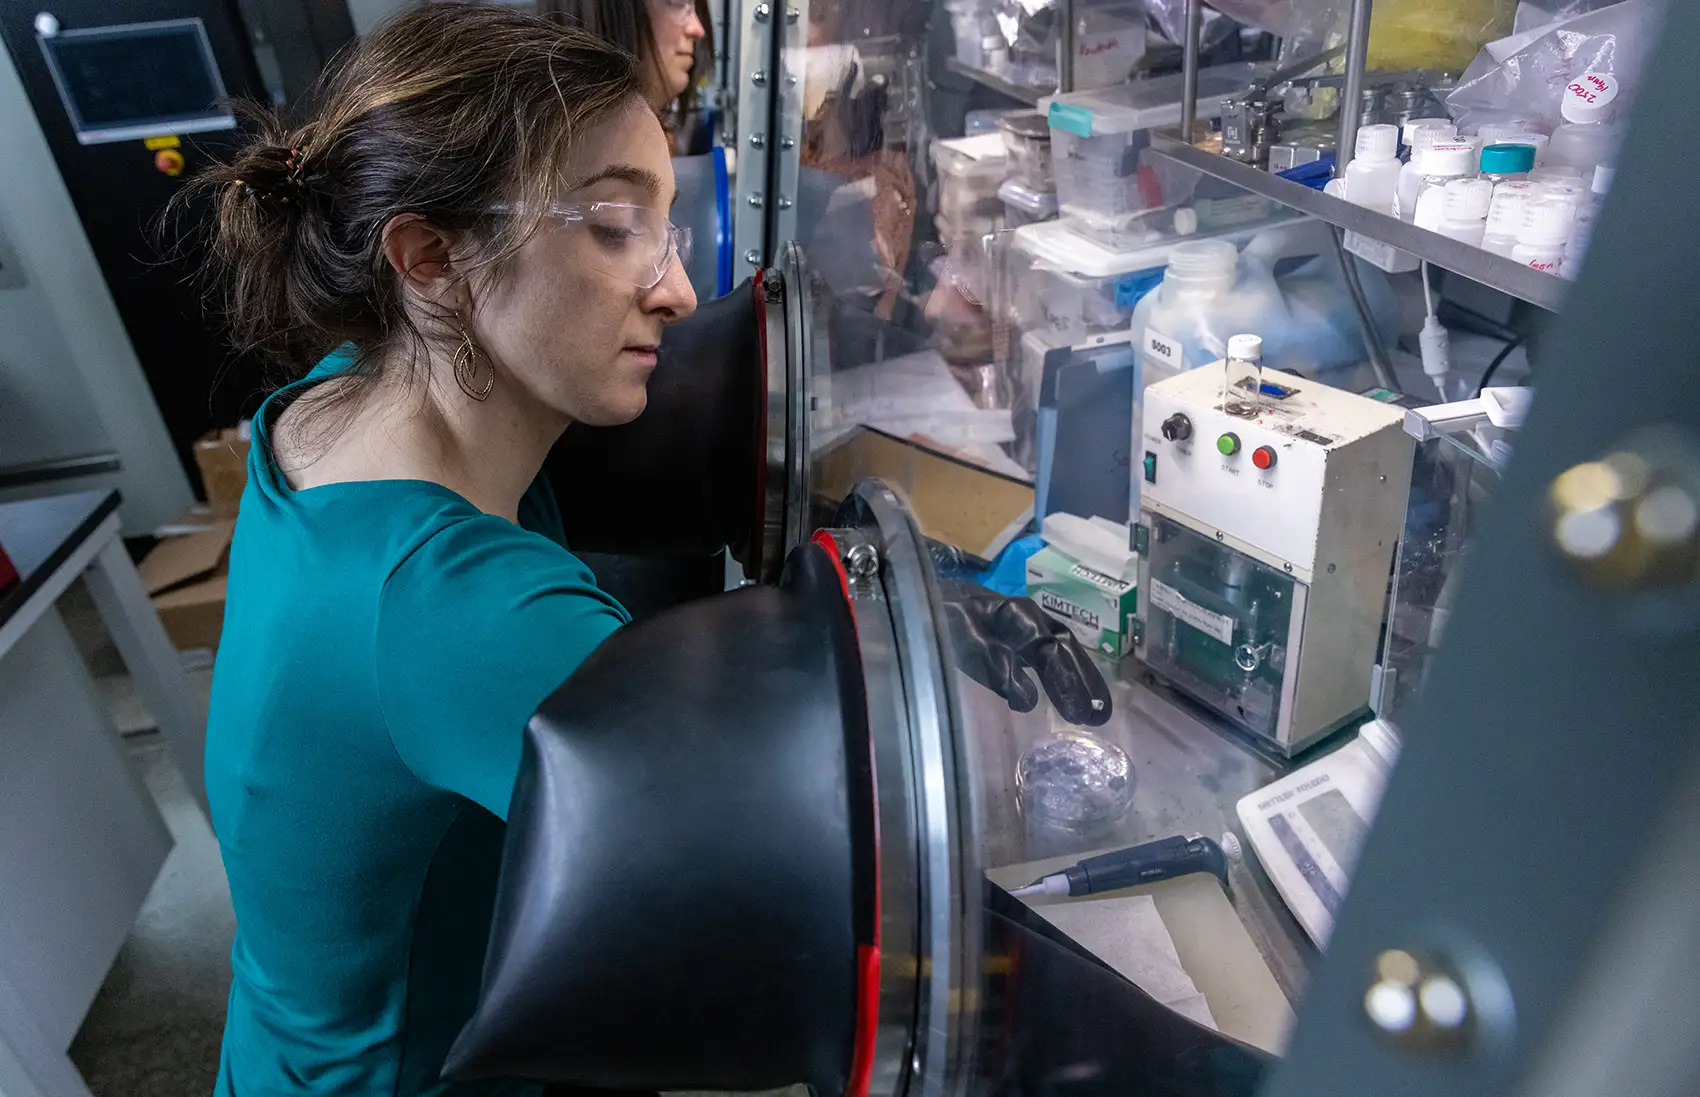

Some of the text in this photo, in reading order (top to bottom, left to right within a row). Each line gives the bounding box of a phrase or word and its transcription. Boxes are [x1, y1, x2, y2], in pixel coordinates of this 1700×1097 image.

[1221, 464, 1240, 477] START
[1257, 478, 1274, 490] STOP
[1042, 592, 1099, 629] KIMTECH
